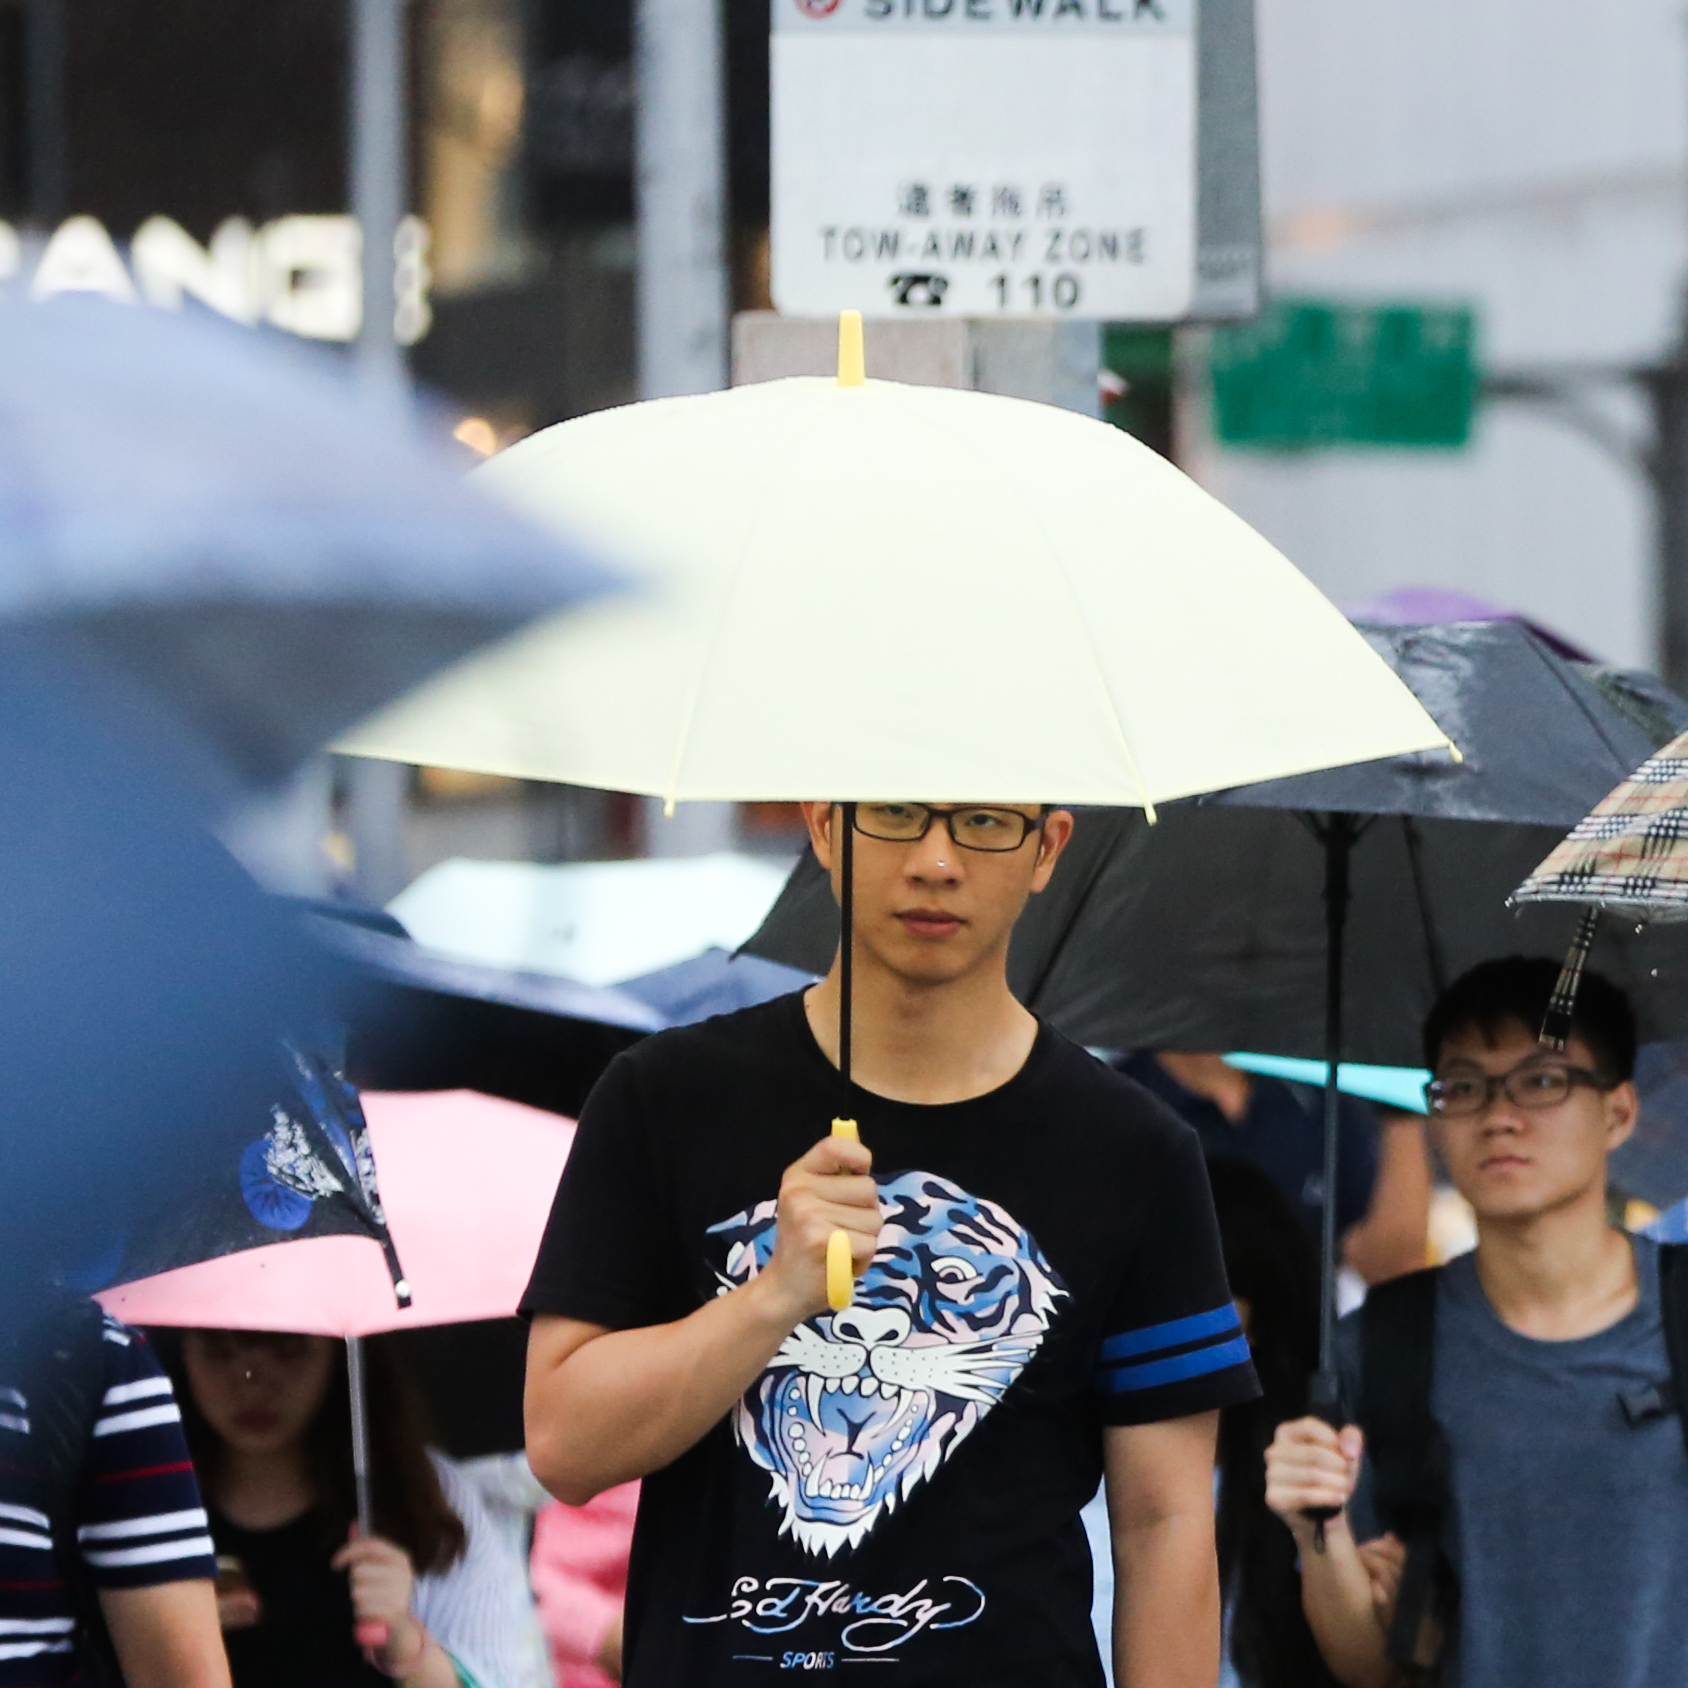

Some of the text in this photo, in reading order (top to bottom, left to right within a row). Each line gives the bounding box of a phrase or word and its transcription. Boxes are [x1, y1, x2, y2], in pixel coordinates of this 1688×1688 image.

[863, 0, 1165, 20] SIDEWALK
[820, 226, 1150, 263] TOW-AWAY ZONE
[990, 273, 1079, 308] 110
[718, 1576, 955, 1651] Ed Hardy
[780, 1651, 835, 1670] SPORTS
